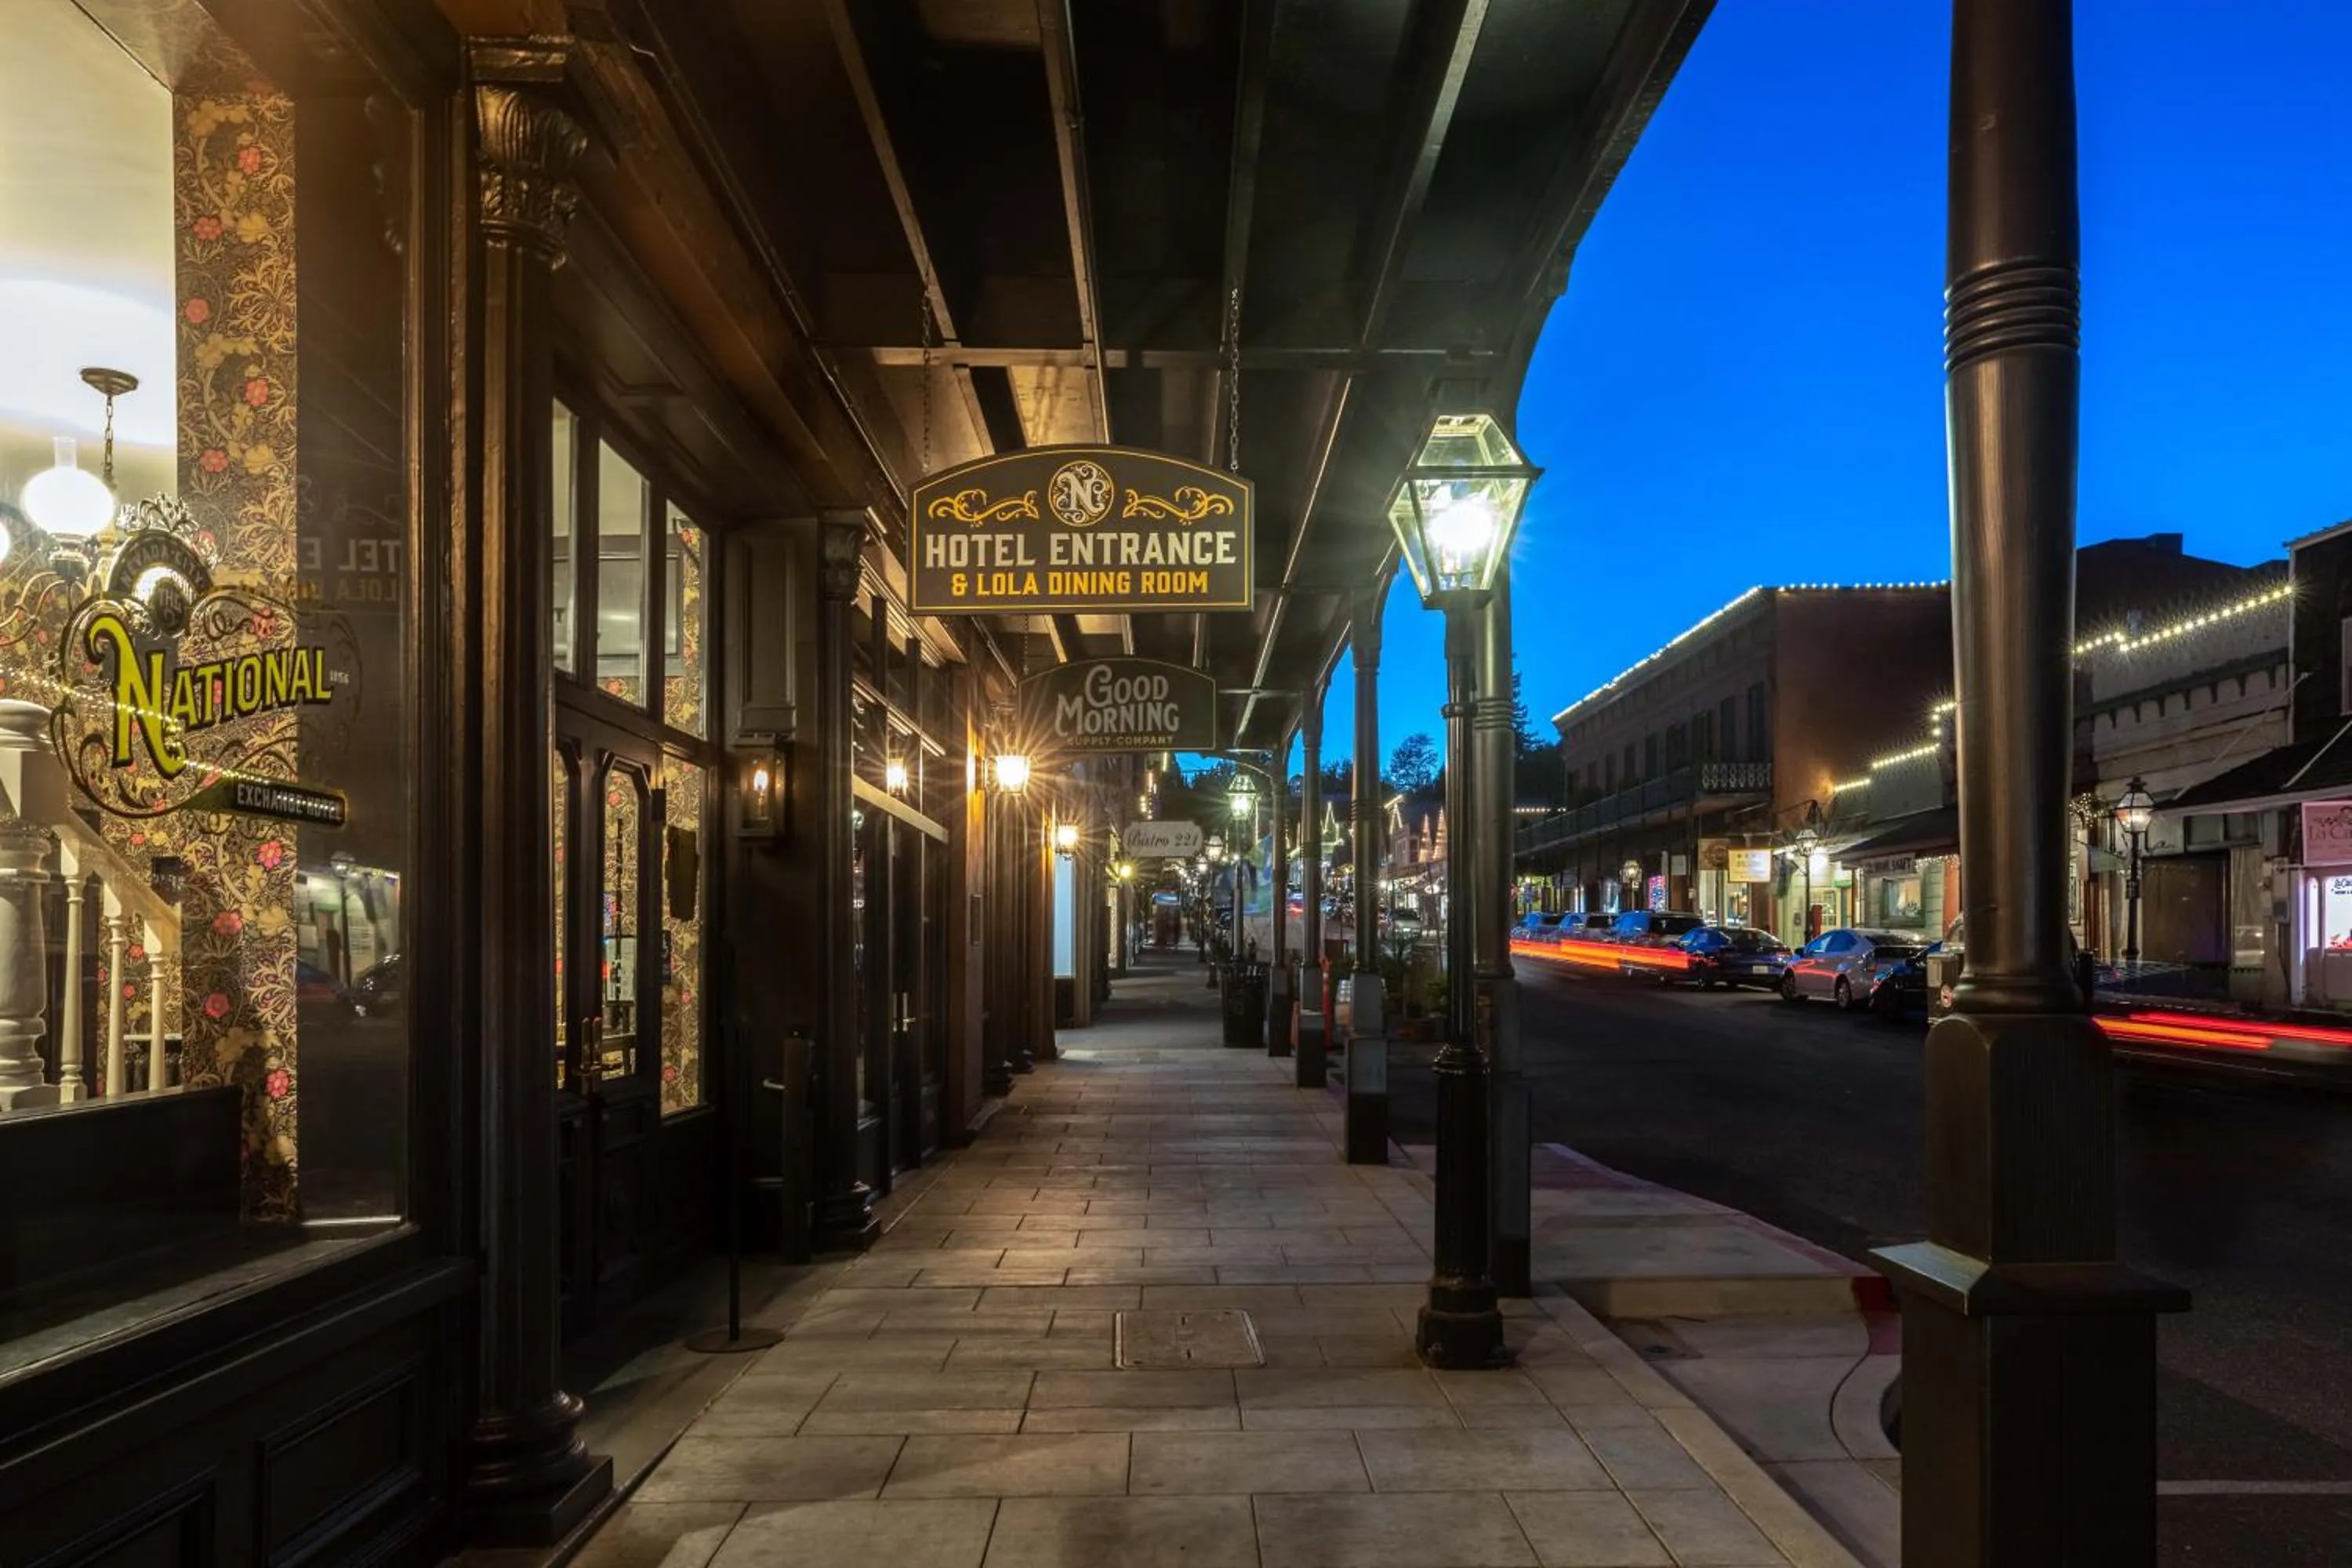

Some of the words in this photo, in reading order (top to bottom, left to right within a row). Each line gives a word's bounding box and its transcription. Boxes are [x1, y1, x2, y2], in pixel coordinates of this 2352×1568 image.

[925, 534, 1036, 568] HOTEL
[1049, 531, 1236, 565] ENTRANCE
[952, 572, 967, 596] &
[977, 572, 1040, 596] LOLA
[1047, 571, 1131, 595] DINING
[1141, 571, 1208, 593] ROOM
[82, 612, 332, 778] NATIONAL
[1085, 664, 1169, 709] GOOD
[1054, 693, 1180, 737] MORNING
[238, 783, 303, 815] EXCHANGE
